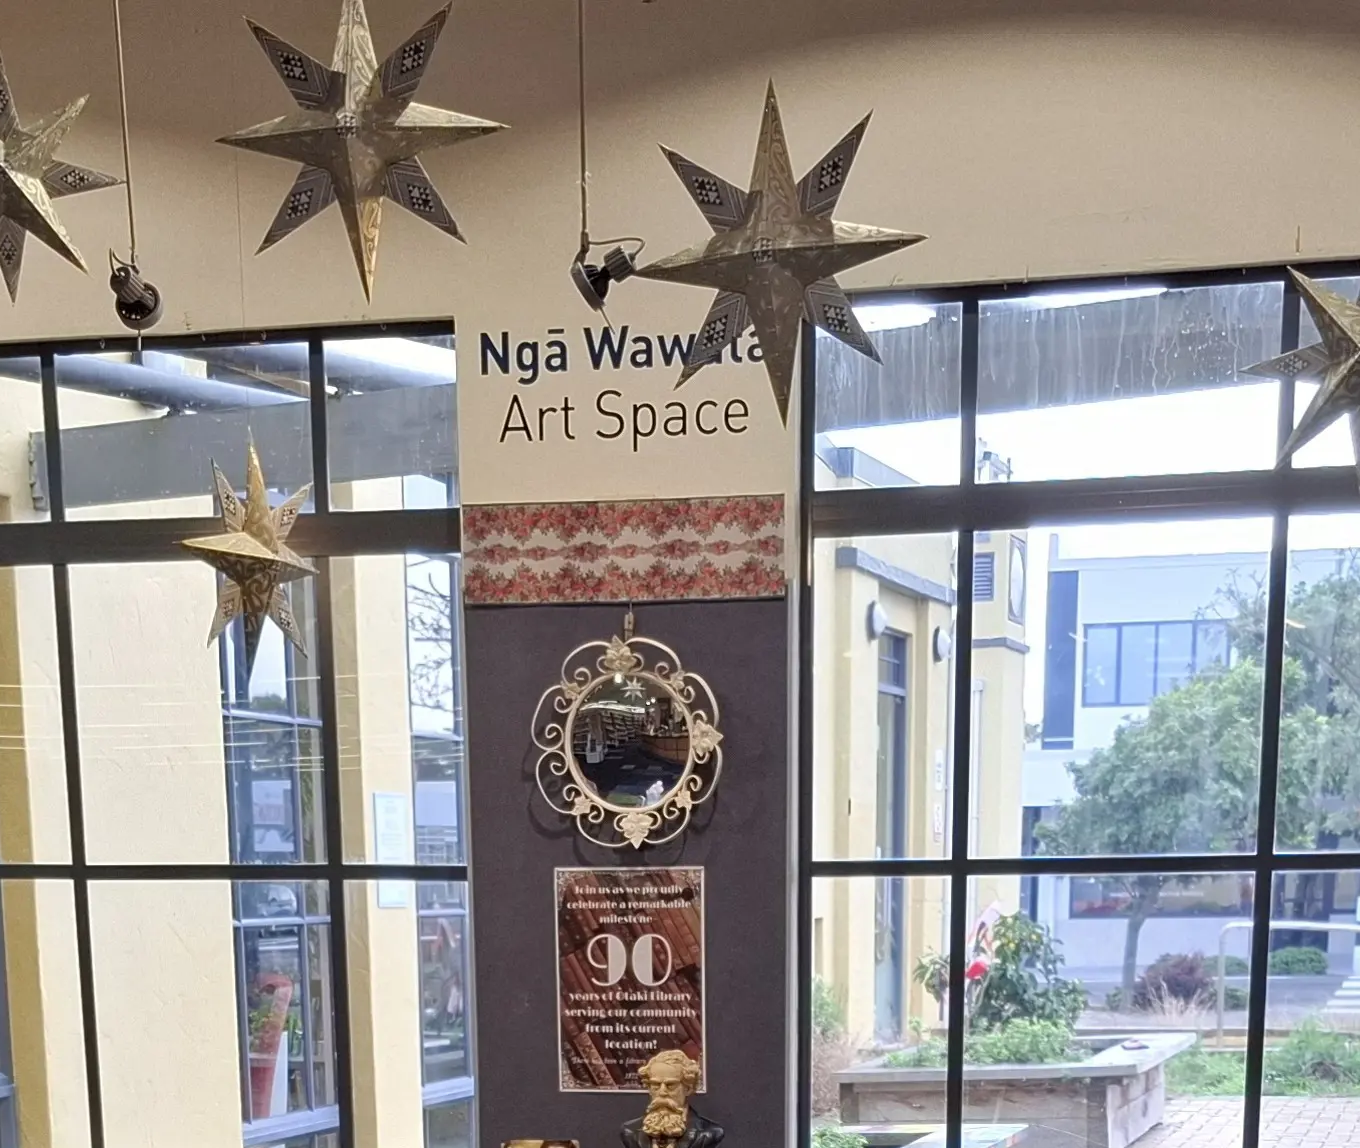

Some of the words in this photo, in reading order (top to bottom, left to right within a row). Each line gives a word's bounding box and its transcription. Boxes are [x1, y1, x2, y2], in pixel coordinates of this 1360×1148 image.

[479, 328, 568, 386] Ngā
[498, 393, 576, 444] Art
[595, 389, 750, 454] Space
[574, 885, 597, 895] Join
[598, 886, 610, 895] us
[612, 886, 625, 895] as
[626, 886, 640, 895] we
[641, 885, 684, 897] proudly
[566, 900, 617, 910] celebrate
[619, 901, 626, 909] a
[627, 900, 692, 910] remarkable
[587, 933, 672, 987] 90
[568, 992, 600, 1002] years
[603, 991, 613, 1001] of
[650, 991, 692, 1002] Library
[564, 1008, 606, 1019] serving
[607, 1009, 627, 1018] our
[629, 1007, 697, 1019] community
[585, 1023, 614, 1034] from
[615, 1023, 631, 1034] its
[632, 1023, 676, 1034] current
[604, 1039, 658, 1050] location!
